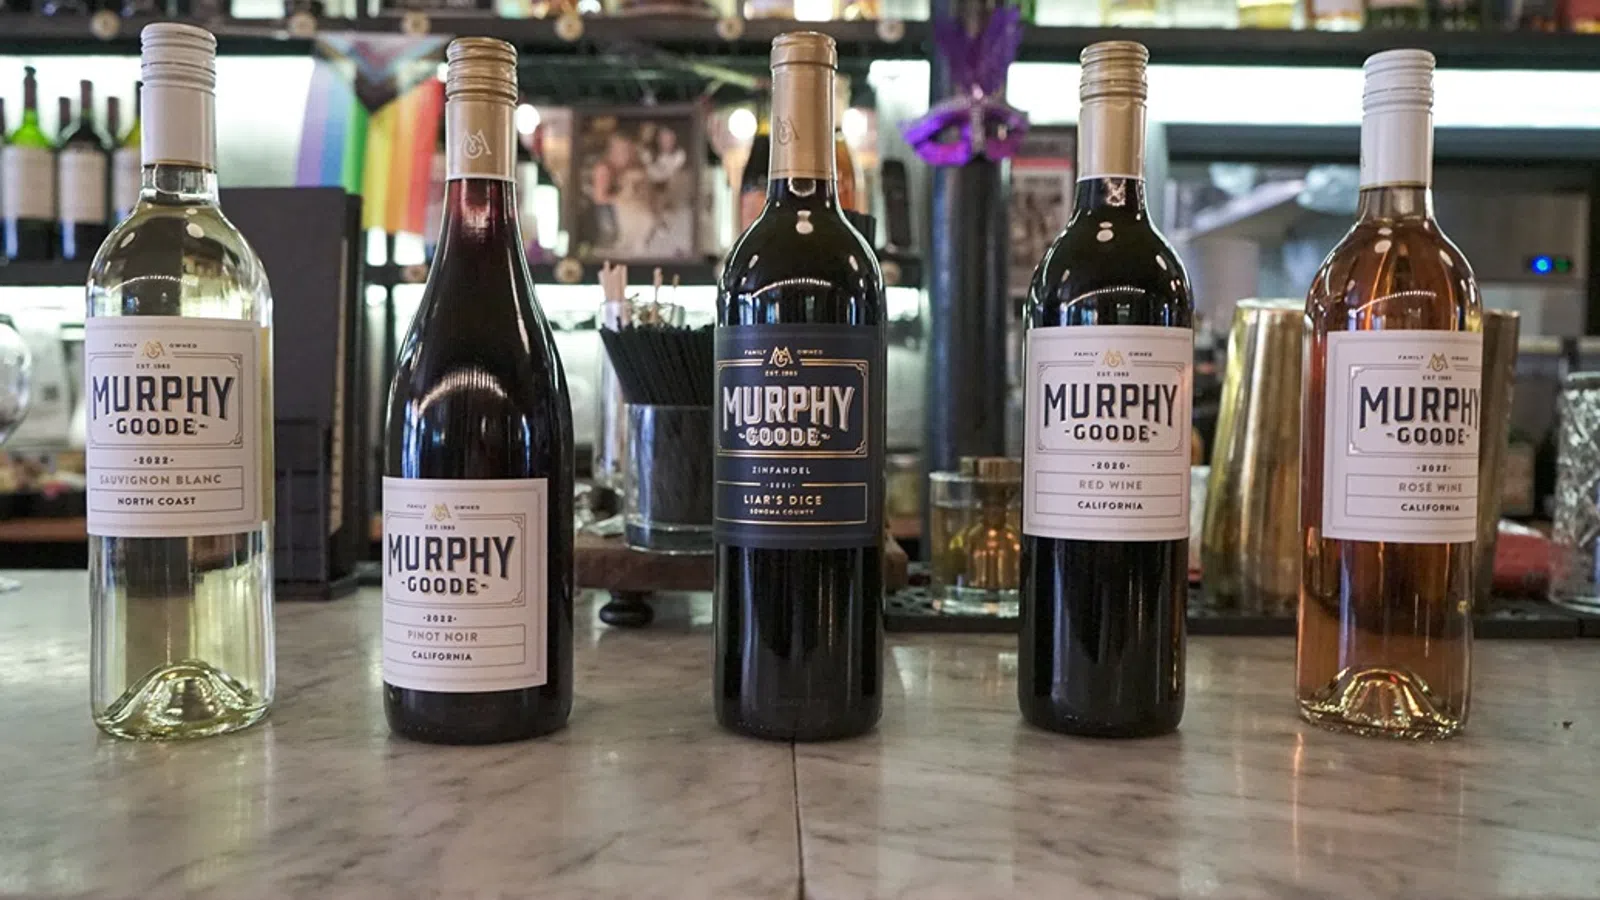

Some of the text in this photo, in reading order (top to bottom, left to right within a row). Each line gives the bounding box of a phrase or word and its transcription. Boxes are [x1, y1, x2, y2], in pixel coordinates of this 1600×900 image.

[92, 375, 236, 421] MURPHY
[723, 386, 855, 432] MURPHY
[1044, 383, 1178, 429] MURPHY
[116, 417, 198, 436] GOODE
[745, 427, 821, 447] GOODE
[1074, 424, 1150, 443] GOODE
[1397, 427, 1465, 445] GOODE
[139, 456, 169, 465] 2022
[752, 466, 811, 475] ZINFANDEL
[100, 474, 222, 485] SAUVIGNON BLANC
[1079, 480, 1143, 490] RED WINE
[1399, 480, 1463, 493] ROSÉ WINE
[117, 497, 196, 506] NORTH COAST
[744, 495, 822, 505] LIAR'S DICE
[1077, 500, 1143, 510] CALIFORNIA
[1401, 503, 1460, 512] CALIFORNIA
[388, 533, 516, 580] MURPHY
[407, 576, 479, 595] GOODE
[426, 614, 453, 623] 2022
[407, 629, 478, 642] PINOT NOIR
[411, 650, 473, 661] CALIFORNIA
